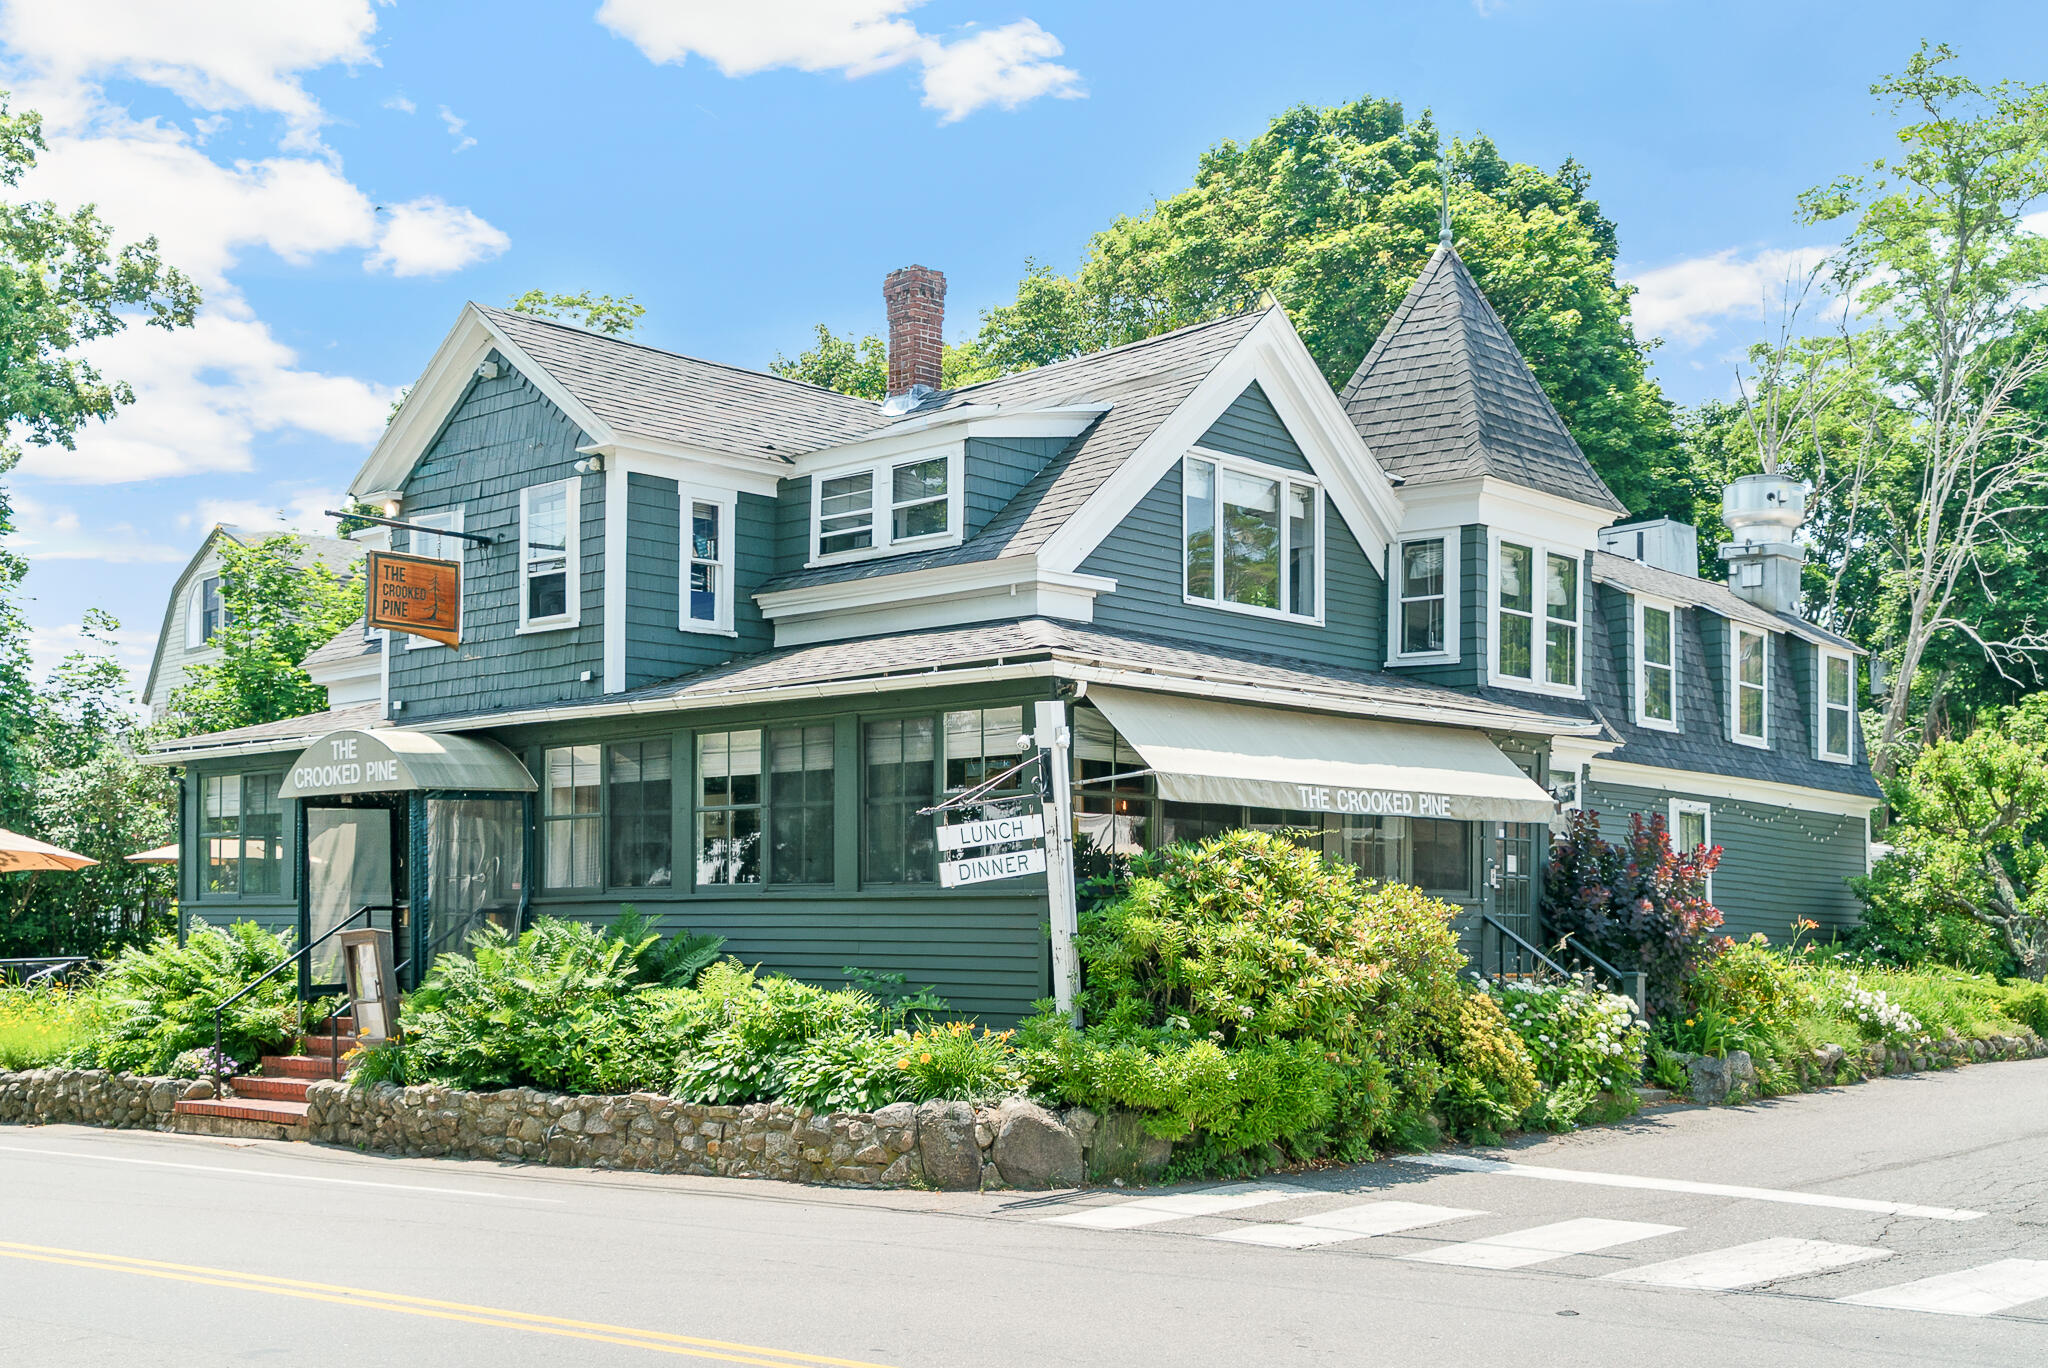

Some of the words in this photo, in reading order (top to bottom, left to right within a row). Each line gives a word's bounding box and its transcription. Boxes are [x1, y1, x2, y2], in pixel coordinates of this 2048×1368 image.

[384, 565, 406, 582] THE
[383, 583, 426, 600] CROOKED
[382, 600, 408, 617] PINE
[330, 739, 357, 760] THE
[294, 763, 360, 789] CROOKED
[366, 760, 398, 782] PINE
[1298, 786, 1330, 809] THE
[1336, 789, 1413, 814] CROOKED
[1418, 794, 1451, 816] PINE
[960, 820, 1024, 844] LUNCH
[958, 855, 1029, 880] DINNER
